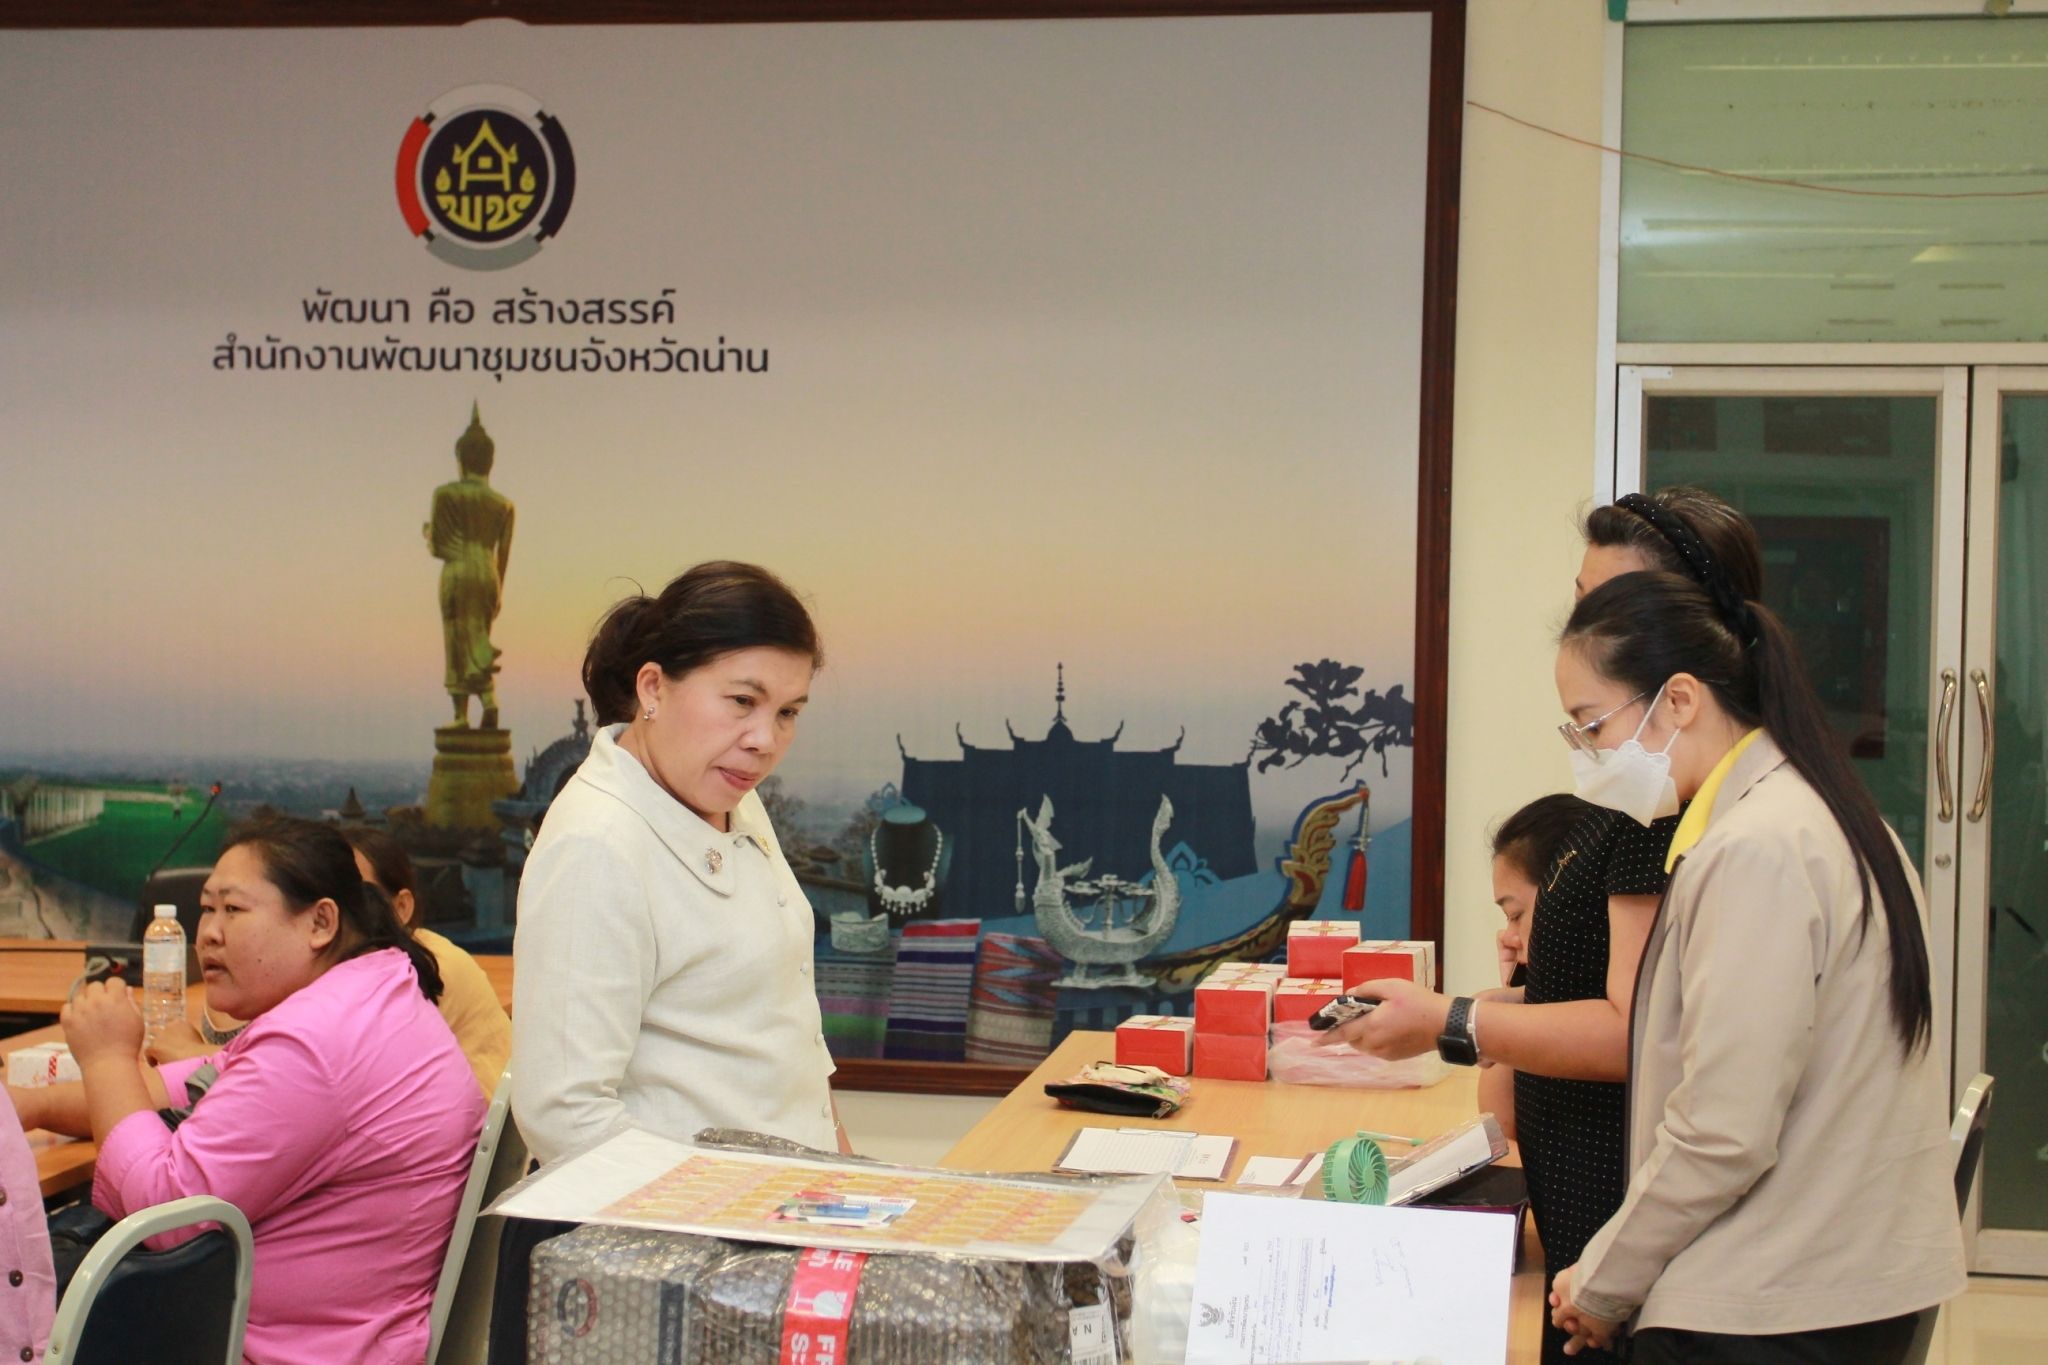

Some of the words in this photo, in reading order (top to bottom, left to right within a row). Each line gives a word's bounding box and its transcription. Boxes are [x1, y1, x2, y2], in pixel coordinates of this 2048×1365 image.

[303, 287, 409, 323] พัฒนา
[429, 287, 474, 323] คือ
[492, 287, 676, 324] สร้างสรรค์
[213, 332, 769, 383] สำนักงานพัฒนาชุมชนจังหวัดน่าน
